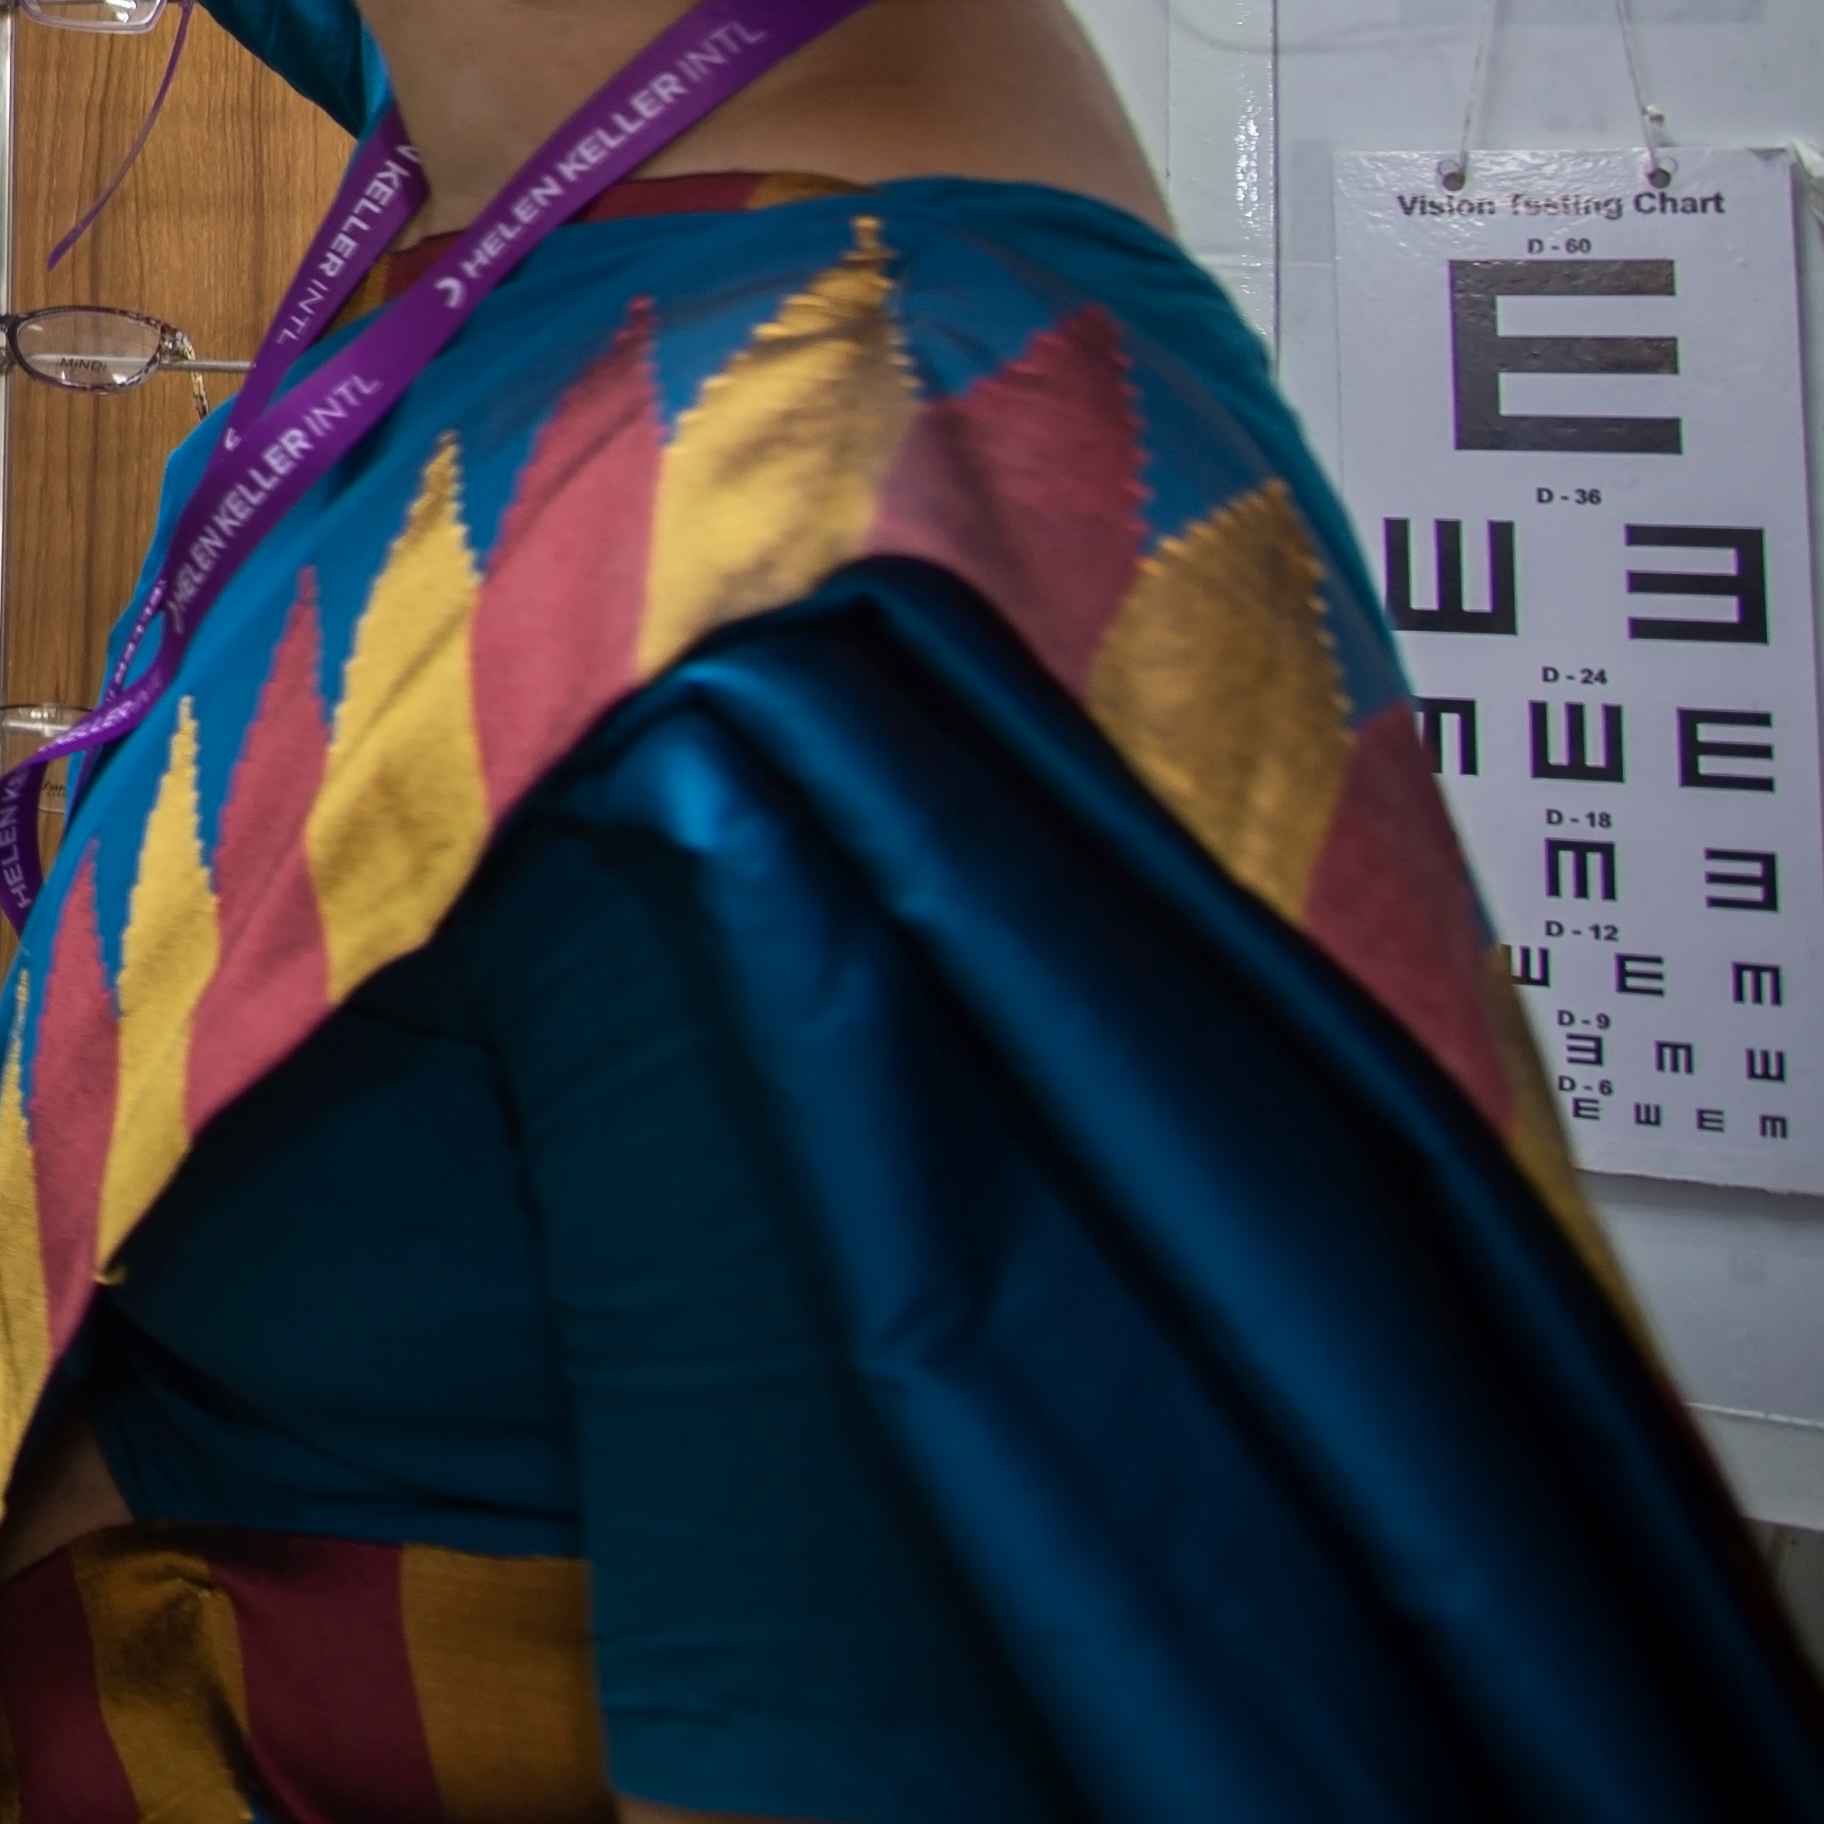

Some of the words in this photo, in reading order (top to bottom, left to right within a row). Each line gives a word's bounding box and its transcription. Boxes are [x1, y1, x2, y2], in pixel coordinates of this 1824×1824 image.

[459, 174, 565, 278] HELEN
[555, 71, 690, 182] KELLER
[674, 21, 768, 84] INTL
[1397, 194, 1496, 218] Vision
[1633, 191, 1726, 215] Chart
[317, 158, 411, 277] KELLER
[1527, 238, 1544, 254] D
[1565, 238, 1592, 254] 60
[275, 278, 329, 345] INTL
[1450, 259, 1683, 455] E
[211, 427, 315, 539] KELLER
[302, 374, 386, 438] INTL
[1536, 487, 1554, 504] D
[1574, 488, 1603, 505] 36
[1541, 666, 1560, 683] D
[1580, 668, 1608, 685] 24
[1545, 808, 1563, 826] D
[1585, 812, 1612, 828] 18
[1545, 920, 1564, 938] D
[1589, 924, 1619, 942] 12
[1557, 1009, 1575, 1027] D
[1596, 1013, 1611, 1030] 9
[1558, 1075, 1576, 1092] D
[1599, 1080, 1613, 1096] 6
